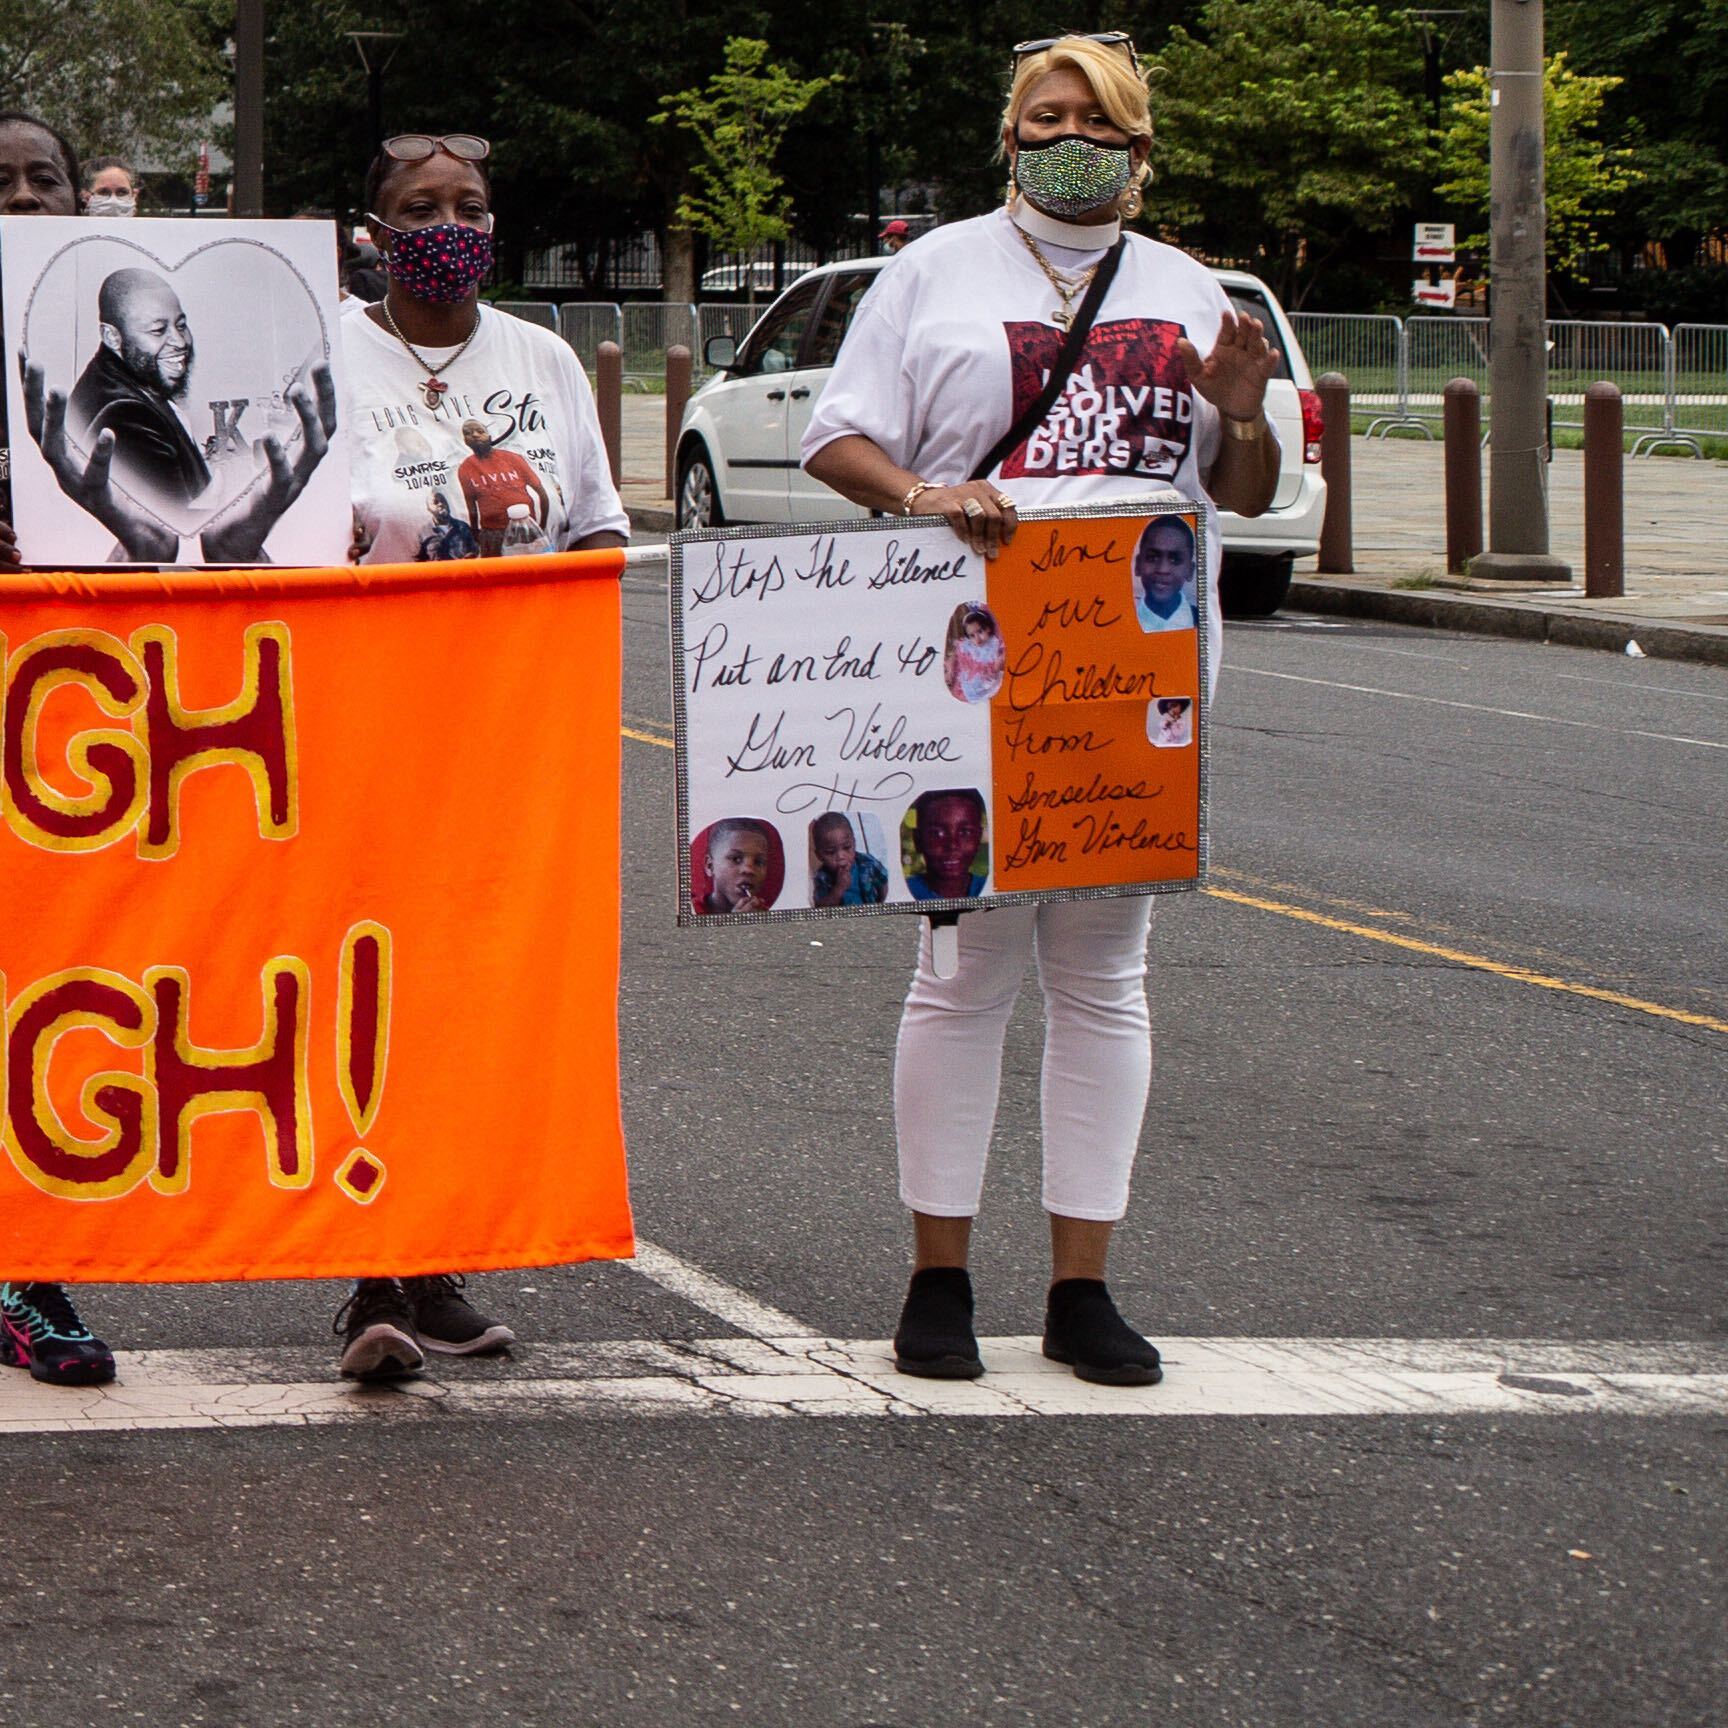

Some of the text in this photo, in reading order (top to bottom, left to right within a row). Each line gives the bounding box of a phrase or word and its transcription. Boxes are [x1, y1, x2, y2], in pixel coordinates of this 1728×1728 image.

[371, 404, 420, 432] LONG
[1045, 385, 1193, 423] SOLVED
[1032, 413, 1121, 444] MUR
[395, 460, 450, 479] SUNRISE
[1023, 439, 1131, 471] DERS
[405, 472, 448, 491] 10/4/90
[470, 471, 520, 488] LIVIN
[690, 535, 968, 611] Stop The Silence
[1028, 595, 1123, 637] our
[684, 623, 763, 693] Put
[767, 654, 818, 683] an
[826, 636, 883, 681] End
[1007, 642, 1162, 712] Children
[726, 703, 962, 779] Gun Violence
[1005, 717, 1114, 760] From
[1009, 772, 1166, 813] Senseless
[1073, 813, 1199, 855] Violence
